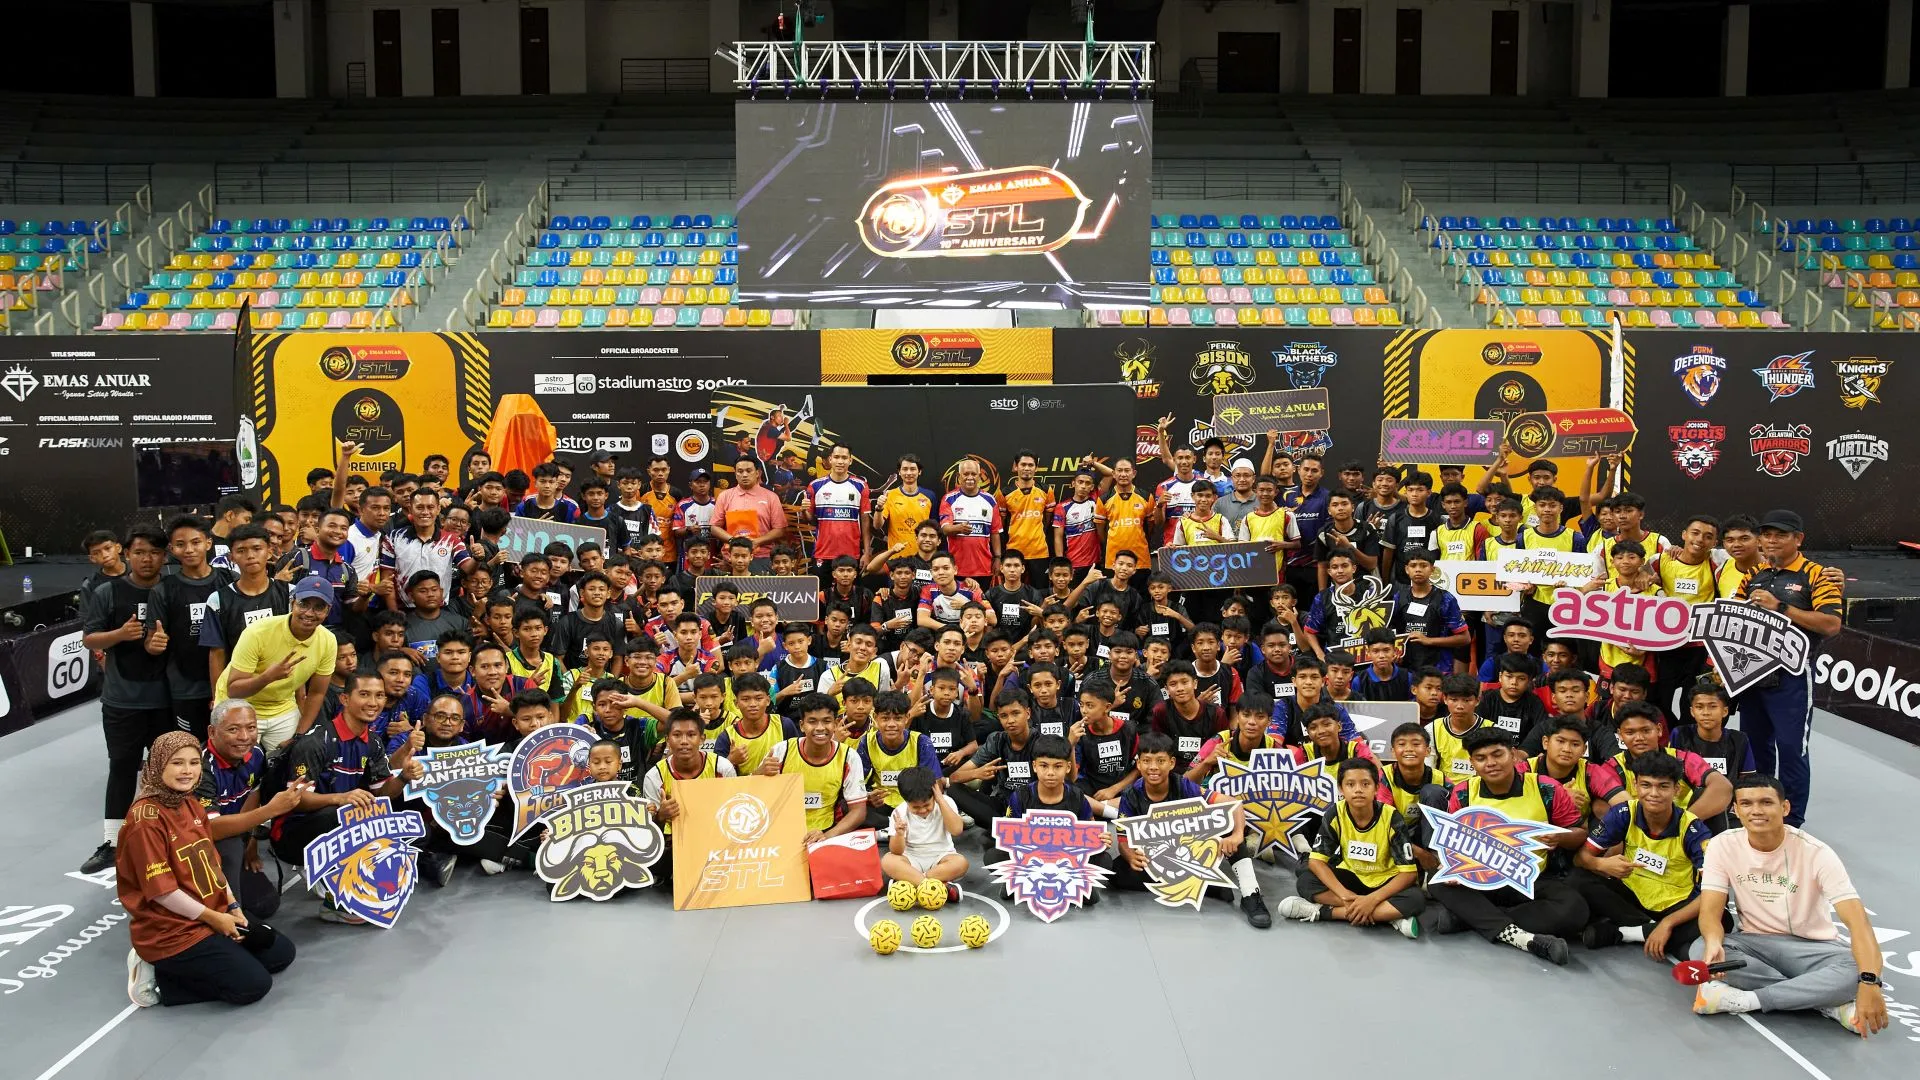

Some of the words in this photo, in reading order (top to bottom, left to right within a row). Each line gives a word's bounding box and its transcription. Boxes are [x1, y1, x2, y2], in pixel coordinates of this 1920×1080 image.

[969, 182, 1003, 195] EMAS
[1005, 176, 1053, 190] ANUAR
[942, 203, 1045, 237] STL
[960, 235, 1045, 249] ANNIVERSARY
[930, 349, 971, 362] STL
[1692, 346, 1713, 354] PDRM
[1199, 351, 1249, 366] BISON
[1278, 354, 1335, 364] PANTHERS
[1674, 354, 1727, 372] DEFENDERS
[358, 362, 398, 373] STL
[1838, 363, 1887, 374] KNIGHTS
[42, 374, 90, 388] EMAS
[94, 373, 152, 388] ANUAR
[1759, 370, 1812, 385] THUNDER
[578, 382, 594, 392] GO
[990, 398, 1019, 408] astro
[1249, 406, 1281, 415] EMAS
[1285, 403, 1327, 413] ANUAR
[1577, 418, 1597, 426] EMAS
[1599, 416, 1626, 425] ANUAR
[345, 425, 391, 440] STL
[1671, 427, 1724, 440] TIGRIS
[1839, 433, 1877, 441] TERENGGANU
[1562, 435, 1617, 454] STL
[1753, 439, 1809, 454] WARRIORS
[1825, 440, 1889, 462] TURTLES
[1171, 549, 1259, 587] Gegar
[1676, 582, 1696, 591] 2225
[1552, 588, 1690, 635] astro
[1719, 603, 1784, 629] TERENGGANU
[1694, 607, 1804, 670] TURTLES
[53, 656, 84, 690] GO
[1276, 686, 1294, 694] 2123
[1042, 726, 1062, 734] 2122
[1500, 719, 1518, 729] 2121
[701, 742, 715, 750] 222
[932, 735, 951, 744] 2160
[1180, 740, 1200, 749] 2175
[436, 747, 479, 760] PENANG
[1100, 744, 1119, 753] 2191
[431, 755, 488, 771] BLACK
[1009, 765, 1028, 774] 2135
[1098, 763, 1124, 773] STL
[1253, 753, 1293, 771] ATM
[1453, 761, 1474, 771] 2215
[411, 760, 509, 789] PANTHERS
[882, 773, 899, 782] 224
[1218, 773, 1333, 802] GUARDIANS
[574, 788, 621, 805] PERAK
[804, 796, 820, 805] 227
[344, 802, 388, 825] PDRM
[555, 802, 647, 838] BISON
[1152, 805, 1203, 820] KPT-MASUM
[1029, 816, 1072, 827] JOHOR
[1131, 809, 1227, 841] KNIGHTS
[998, 824, 1103, 848] TIGRIS
[311, 815, 421, 875] DEFENDERS
[1350, 846, 1375, 856] 2230
[1436, 815, 1534, 887] THUNDER
[1461, 826, 1489, 843] KUALA
[1491, 839, 1527, 862] LUMPUR
[708, 846, 780, 861] KLINIK
[1636, 853, 1663, 869] 2233
[700, 860, 785, 893] STL
